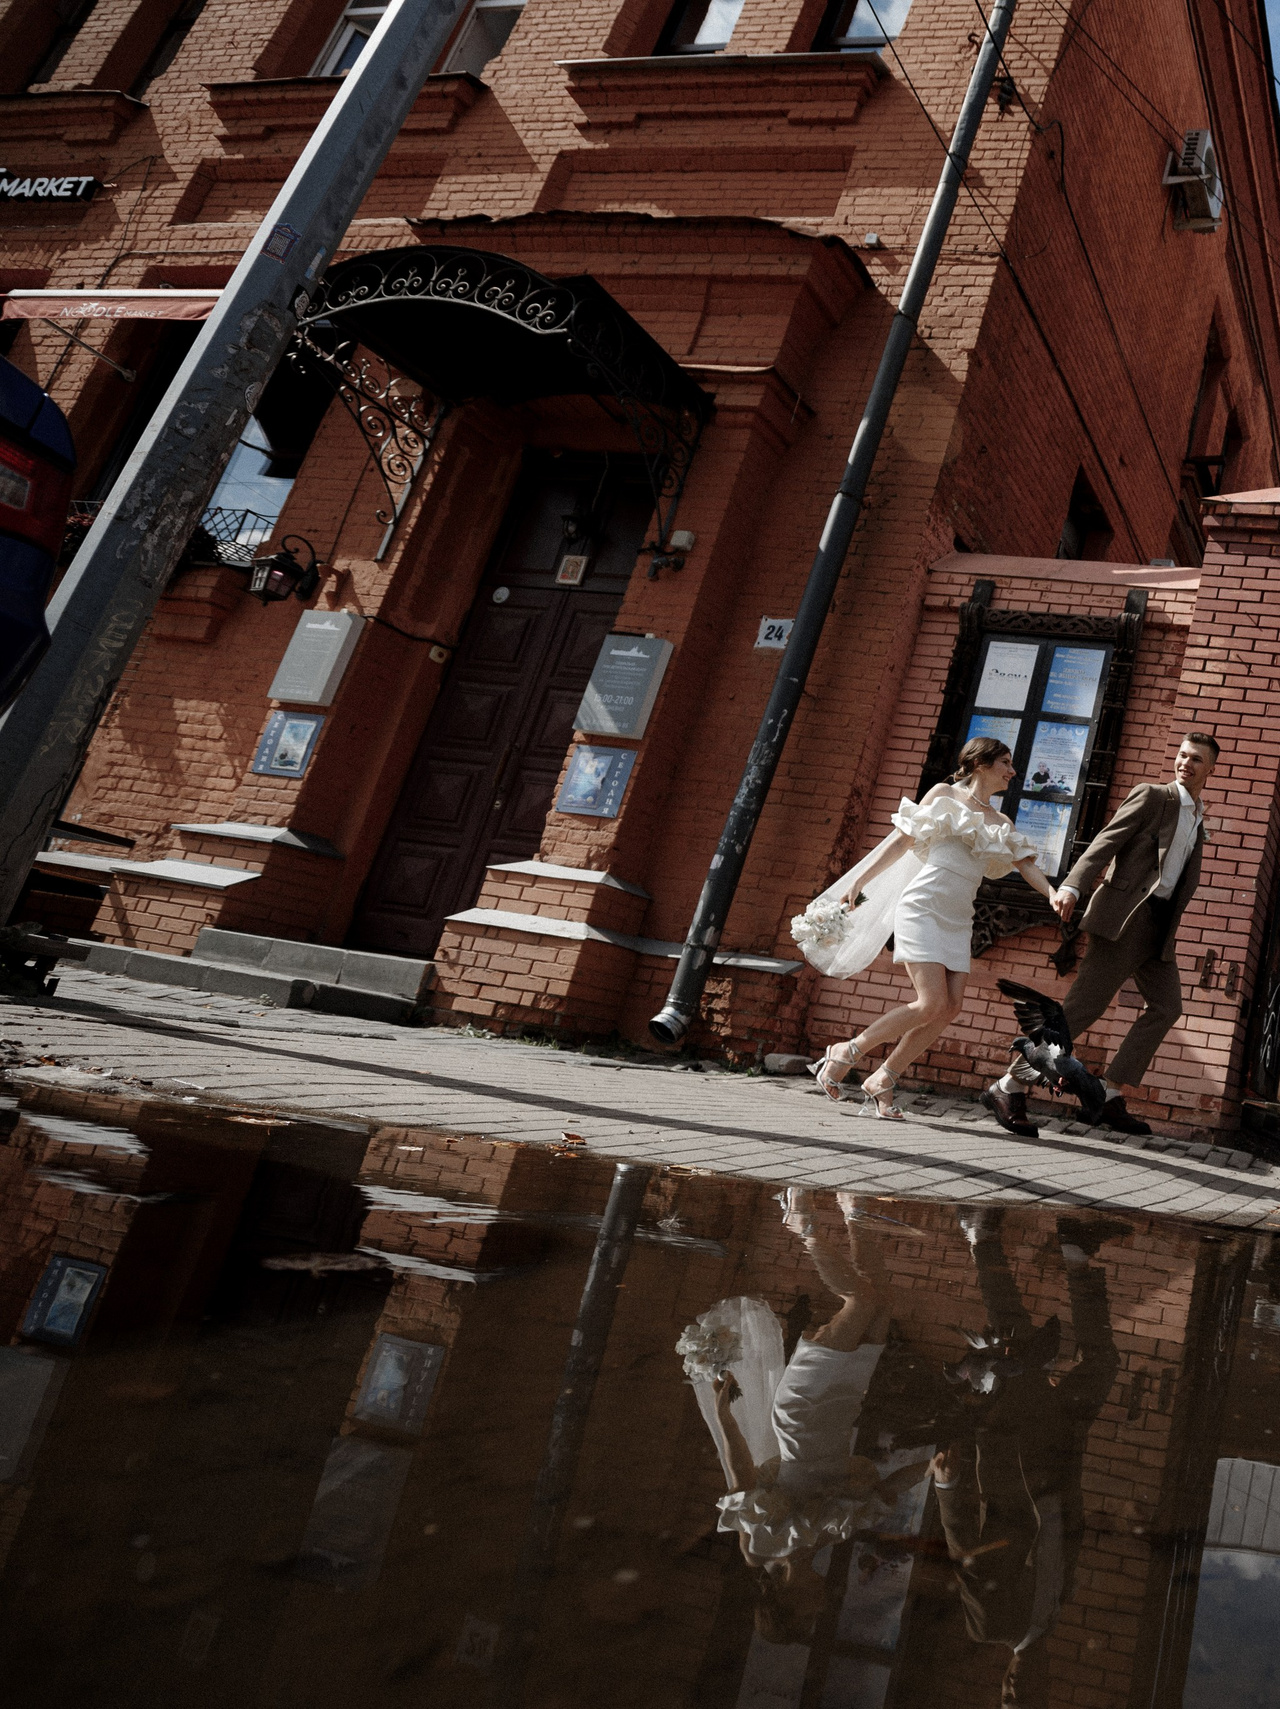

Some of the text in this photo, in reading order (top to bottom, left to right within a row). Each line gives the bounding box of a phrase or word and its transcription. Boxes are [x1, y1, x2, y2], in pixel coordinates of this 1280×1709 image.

[0, 176, 94, 197] MARKET
[764, 625, 784, 641] 24
[602, 753, 627, 814] СЕГОДНЯ
